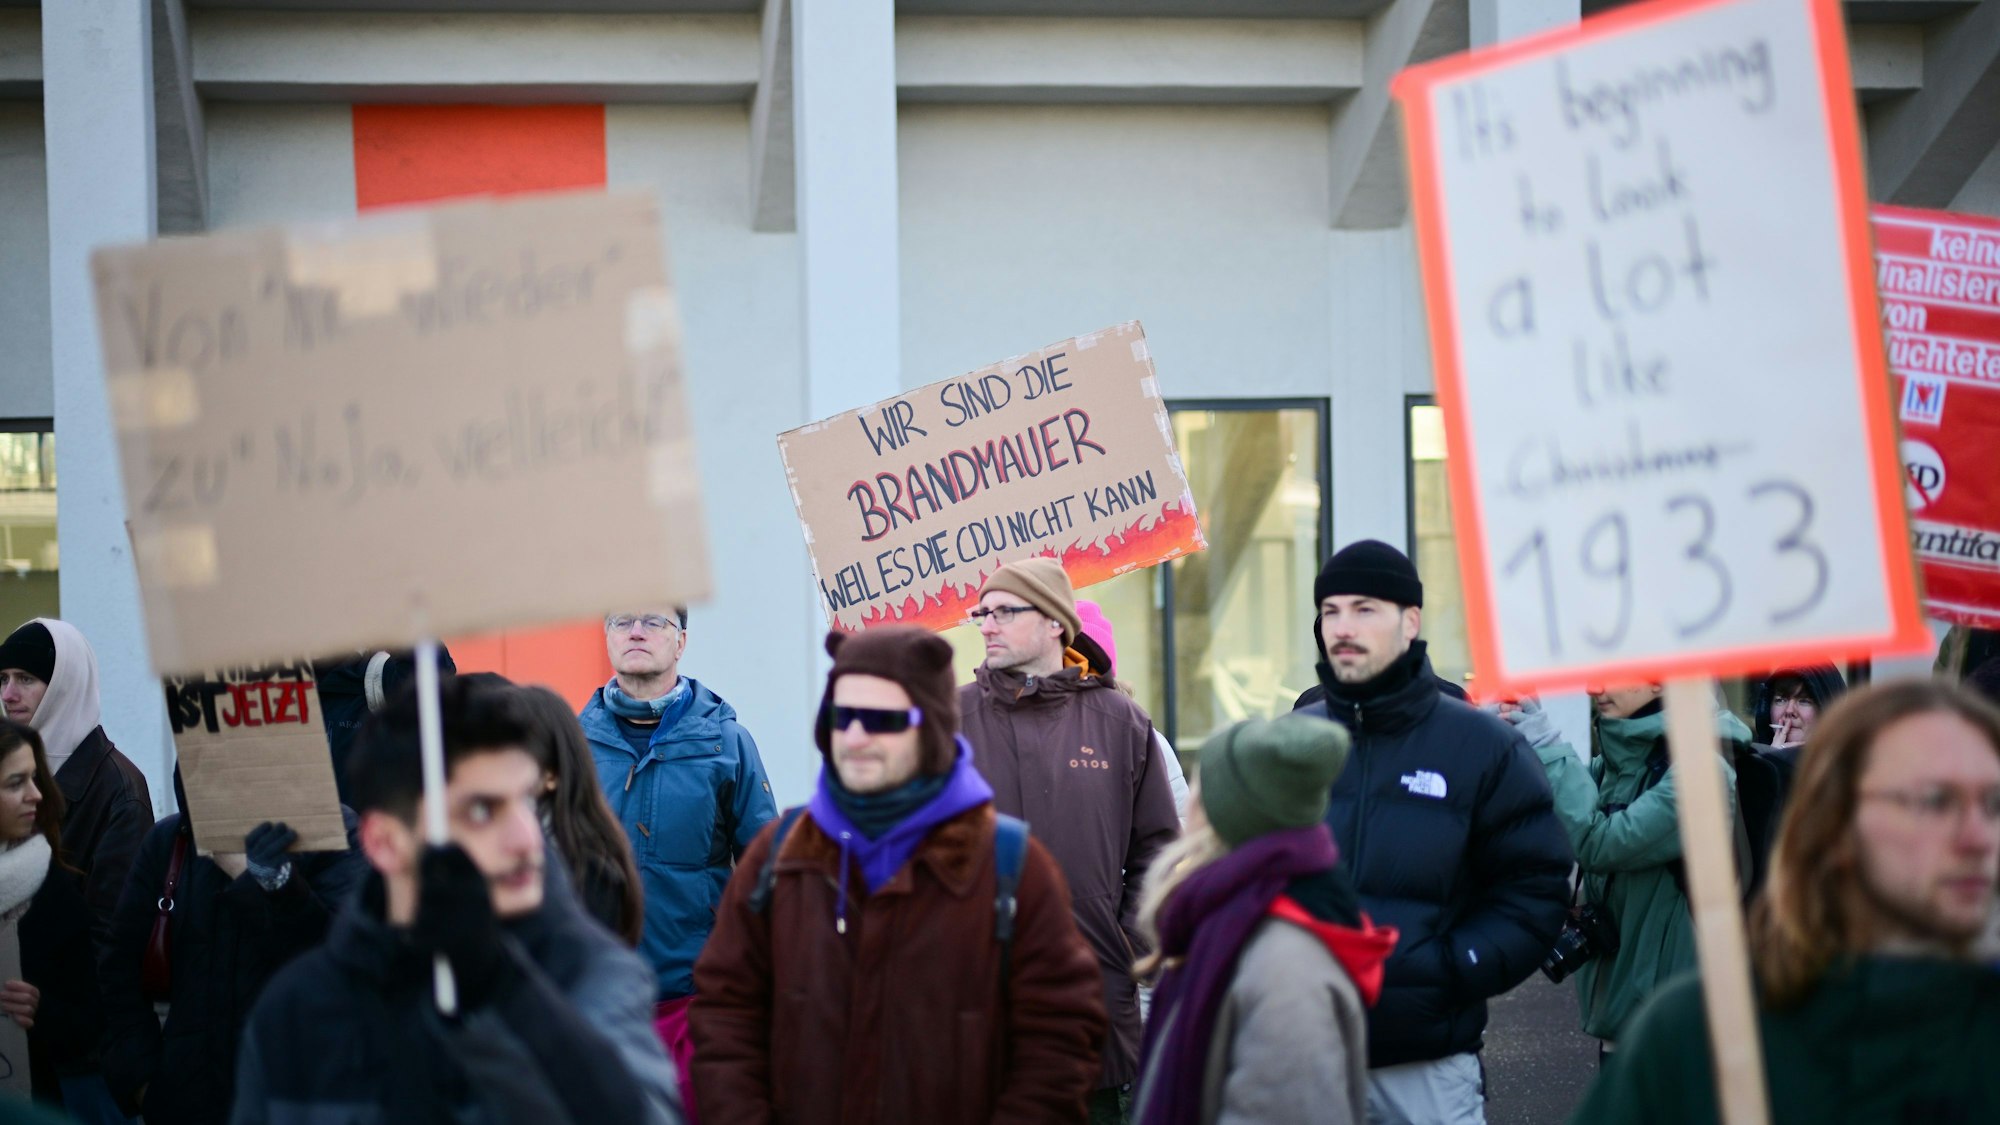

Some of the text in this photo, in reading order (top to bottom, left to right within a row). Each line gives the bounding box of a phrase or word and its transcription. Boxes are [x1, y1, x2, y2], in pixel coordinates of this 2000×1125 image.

[1555, 38, 1776, 149] beginning
[1517, 135, 1689, 233] to look
[121, 278, 248, 370] Von
[1489, 213, 1718, 338] a lot
[1878, 258, 2000, 303] inalisier
[859, 352, 1073, 456] WIR SIND DIE
[1575, 328, 1671, 406] like
[1886, 334, 2000, 379] üchtete
[848, 407, 1106, 542] BRANDMAUER
[821, 470, 1157, 612] WEIL ES DIE CDU NICHT KANN
[1505, 479, 1831, 657] 1933
[166, 680, 314, 734] IST JETZT
